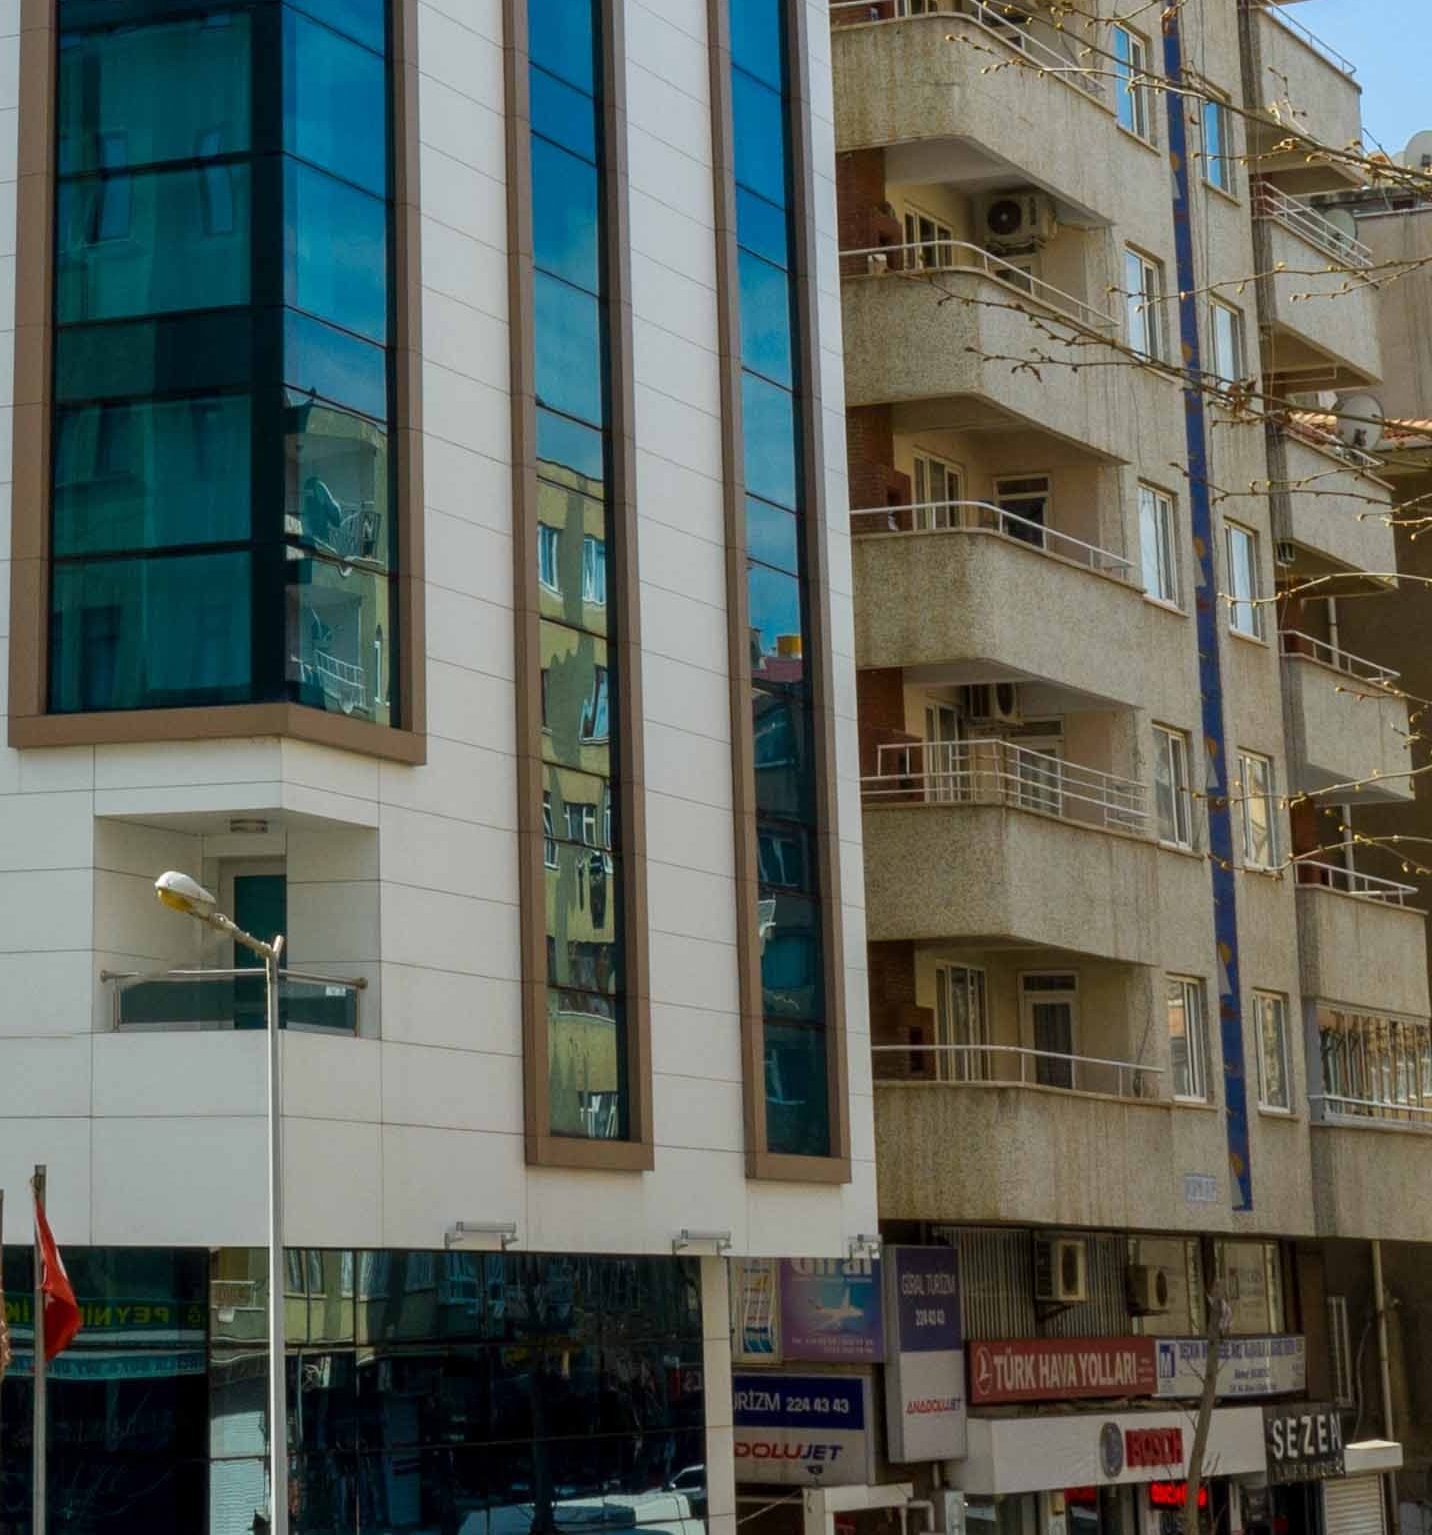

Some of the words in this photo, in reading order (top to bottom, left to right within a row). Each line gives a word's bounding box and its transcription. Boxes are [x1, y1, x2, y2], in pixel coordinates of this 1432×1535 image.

[993, 1347, 1036, 1391] TÜRK
[1039, 1352, 1077, 1389] HAVA
[1078, 1351, 1137, 1386] YOLLARI
[786, 1397, 810, 1413] 224
[814, 1397, 829, 1412] 43
[833, 1397, 849, 1412] 43
[906, 1398, 962, 1414] ANADOLUJET
[1125, 1428, 1183, 1467] BOSCH
[1272, 1411, 1343, 1460] SEZEN
